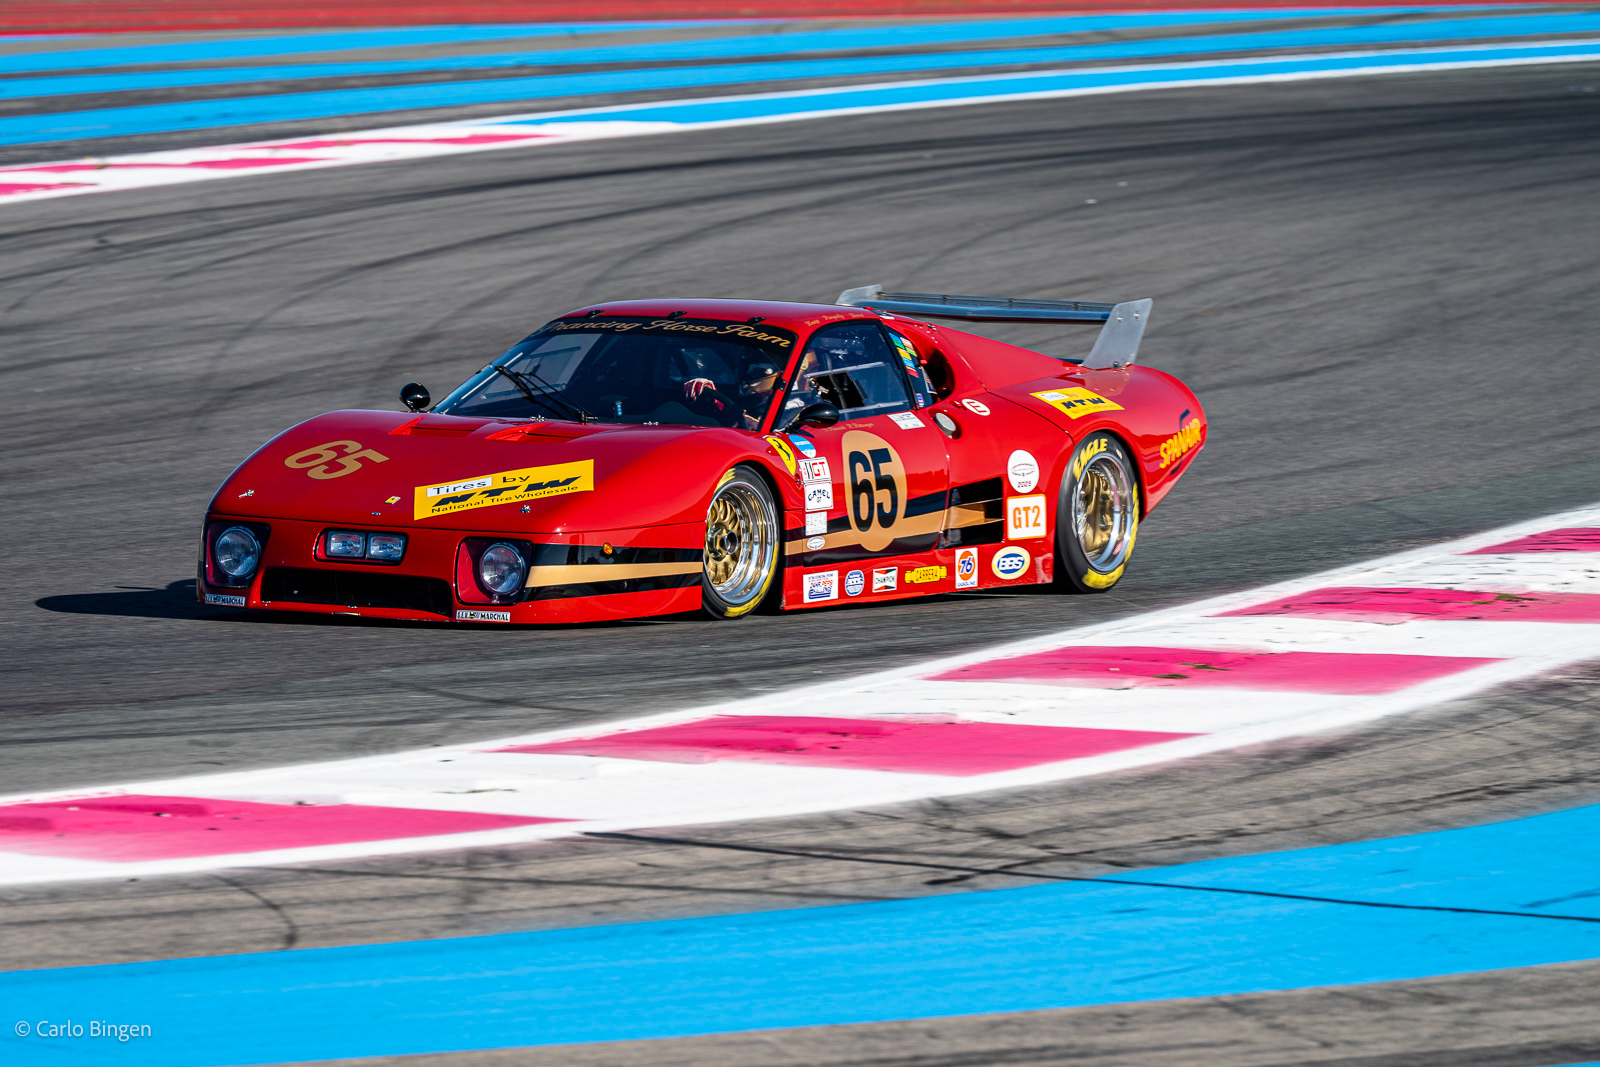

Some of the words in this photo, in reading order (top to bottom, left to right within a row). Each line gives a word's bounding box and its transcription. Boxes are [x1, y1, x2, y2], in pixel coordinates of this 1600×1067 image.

[544, 320, 643, 332] Prancing
[642, 319, 719, 333] Horse
[716, 323, 791, 348] Farm
[1061, 397, 1106, 410] NTW
[1160, 418, 1202, 469] SPANAIR
[284, 440, 391, 480] 65
[1073, 438, 1109, 483] EAGLE
[432, 475, 583, 508] NTW
[433, 481, 488, 495] Tires
[502, 475, 531, 484] by
[807, 489, 831, 501] CAMEL
[848, 448, 899, 532] 65
[431, 499, 484, 514] National
[490, 496, 513, 504] Tire
[514, 485, 579, 500] Wholesale
[1012, 505, 1042, 529] GT2
[959, 556, 974, 574] 76
[998, 557, 1025, 571] BBS
[480, 612, 509, 621] MARCHAL
